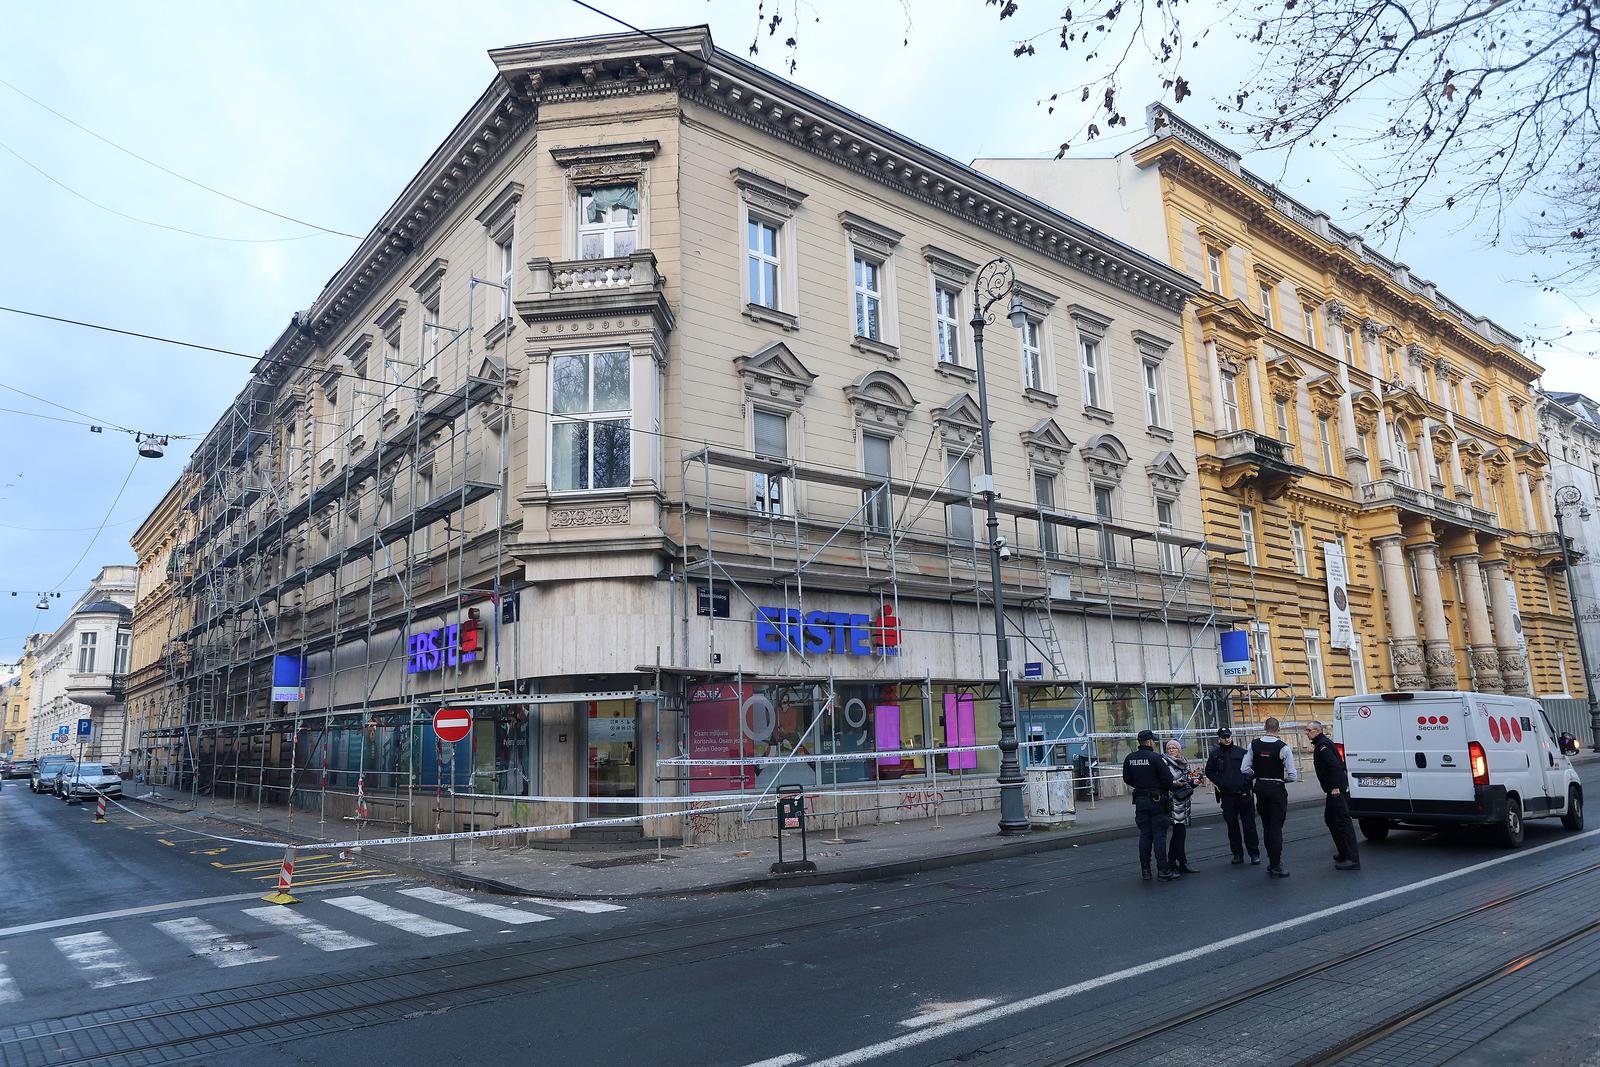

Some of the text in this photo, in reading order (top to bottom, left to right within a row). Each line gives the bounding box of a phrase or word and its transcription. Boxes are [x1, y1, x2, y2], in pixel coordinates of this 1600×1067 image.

[407, 623, 458, 674] ERSTE
[755, 606, 871, 656] ERSTE
[1224, 667, 1241, 675] ERSTE
